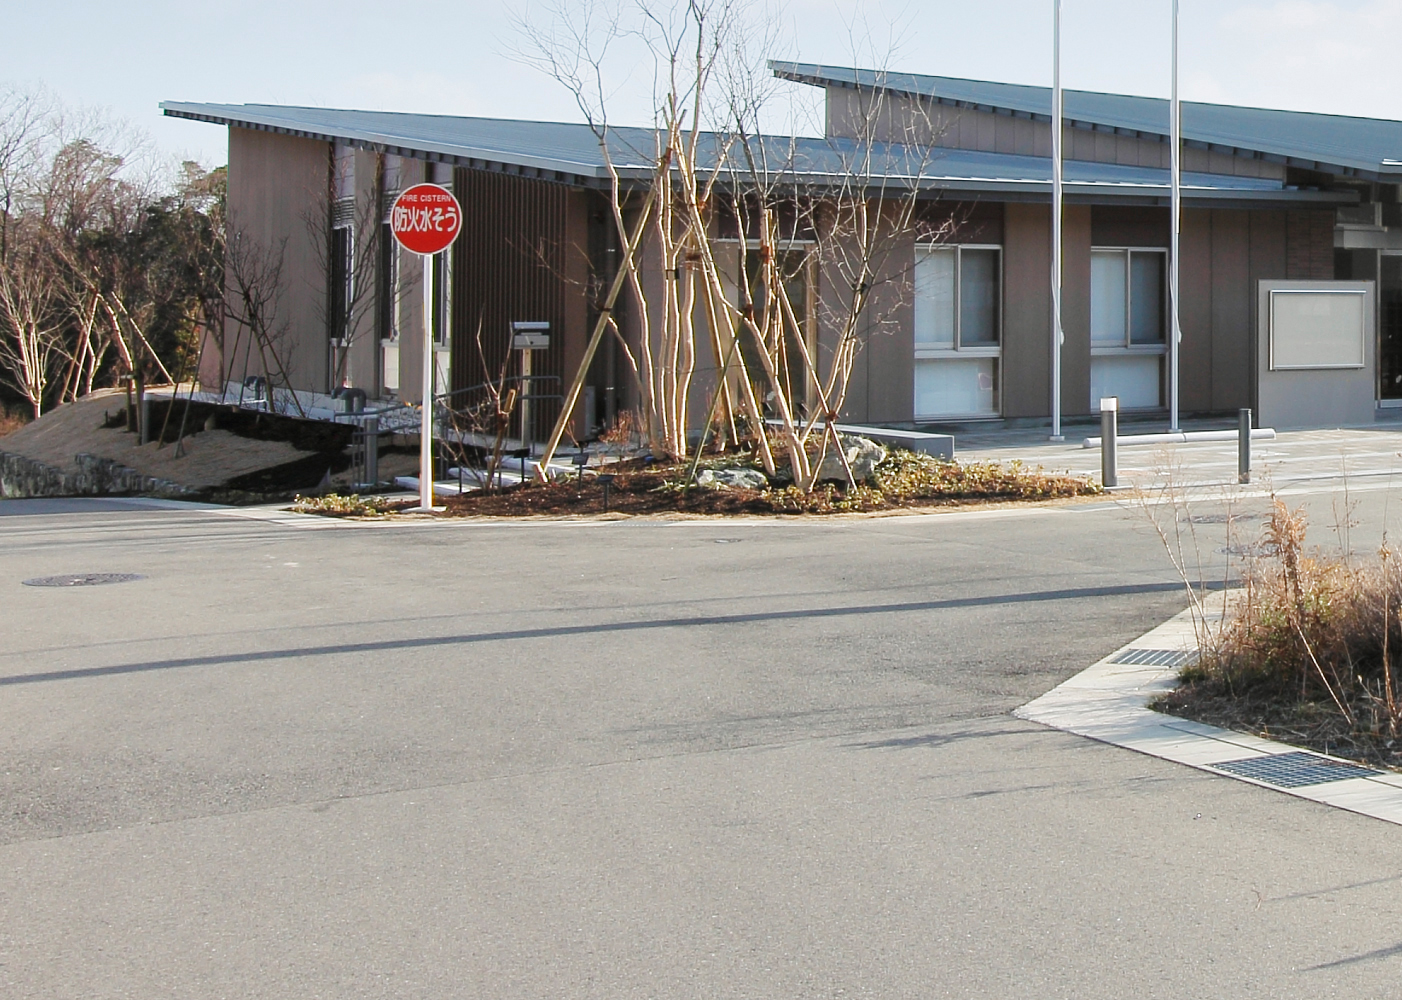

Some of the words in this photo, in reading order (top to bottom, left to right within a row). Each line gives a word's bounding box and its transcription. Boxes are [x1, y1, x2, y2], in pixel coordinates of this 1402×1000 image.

[402, 194, 418, 202] FIRE
[420, 194, 452, 202] CISTERN
[394, 205, 458, 232] 防火水そう
